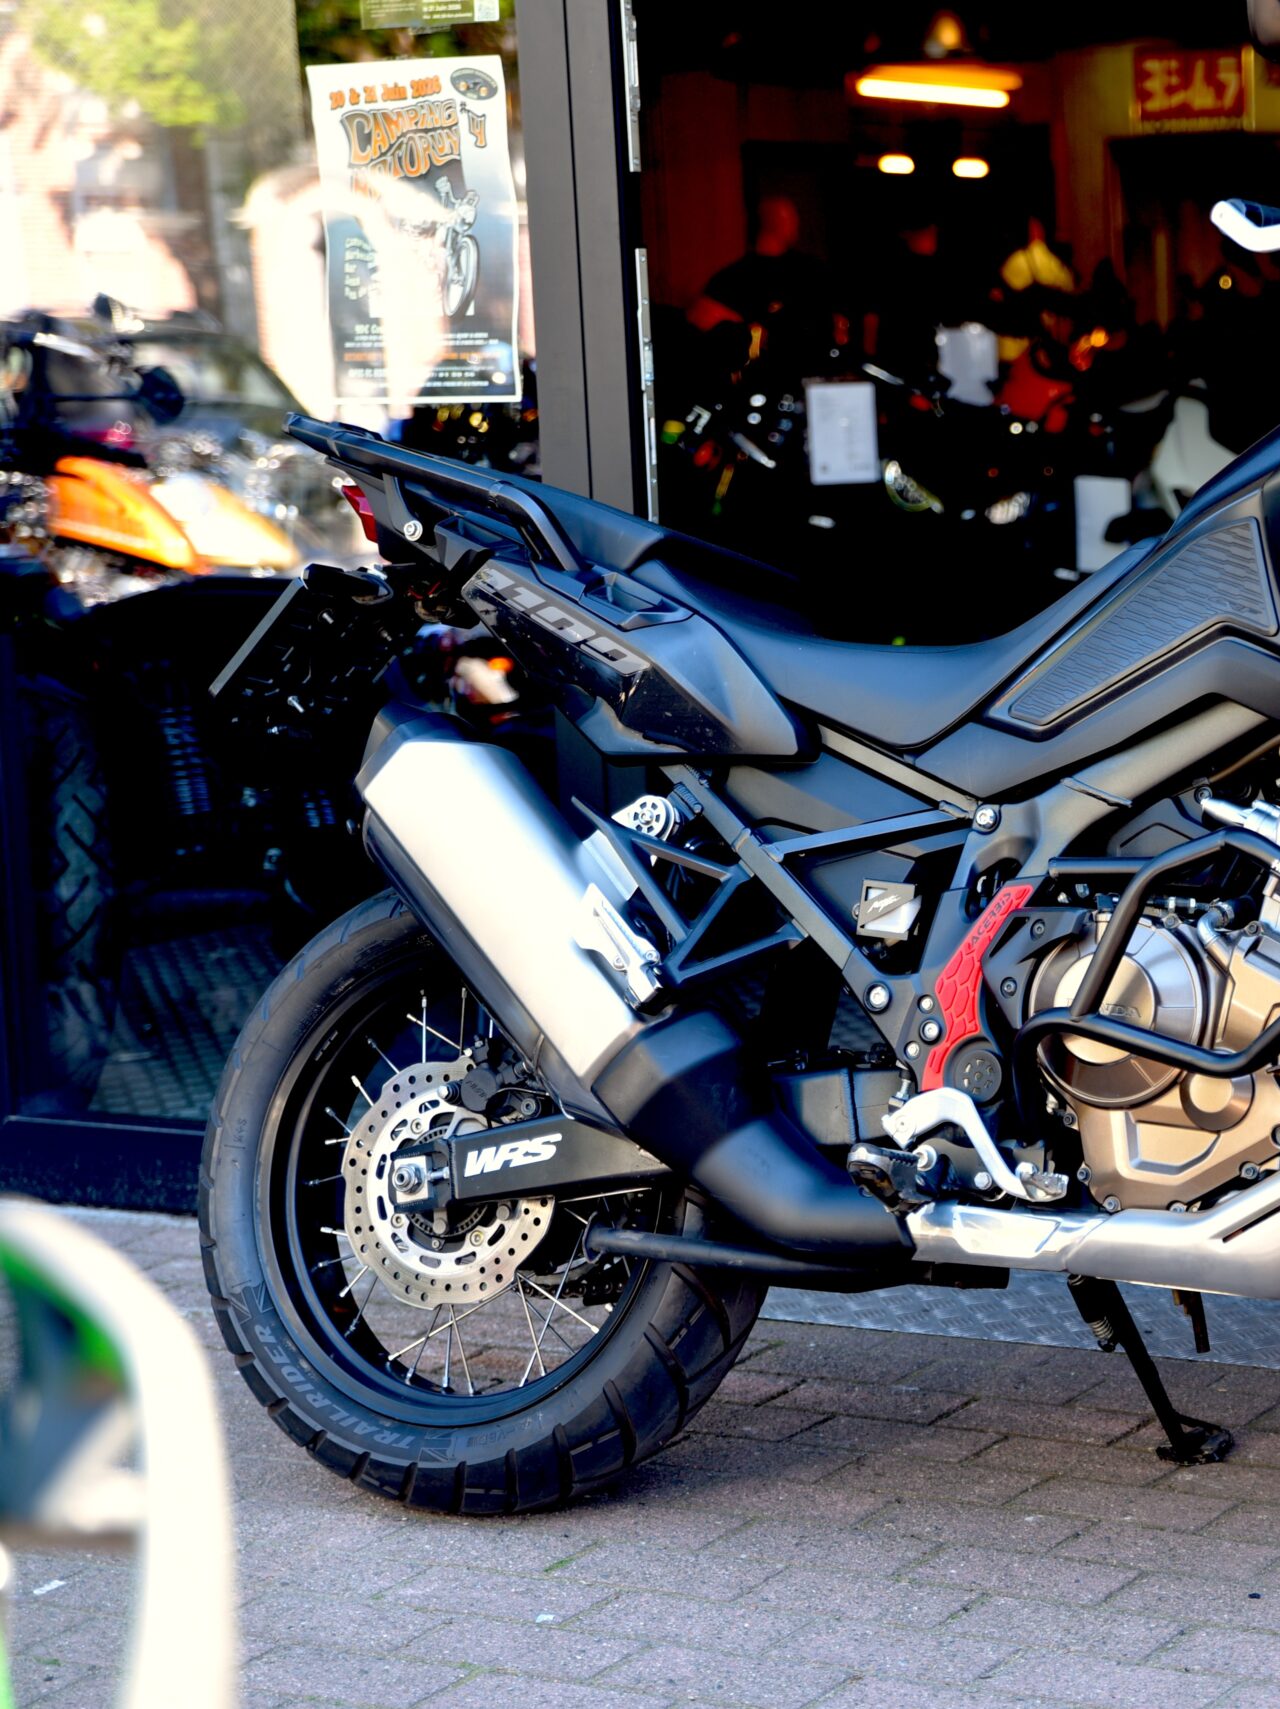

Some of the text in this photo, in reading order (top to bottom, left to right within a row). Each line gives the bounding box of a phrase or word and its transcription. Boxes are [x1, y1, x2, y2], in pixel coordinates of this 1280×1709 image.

[341, 98, 459, 168] CAMPING
[474, 567, 651, 677] 1100
[464, 1133, 563, 1178] WRS
[253, 1323, 419, 1449] TRAILRIDER
